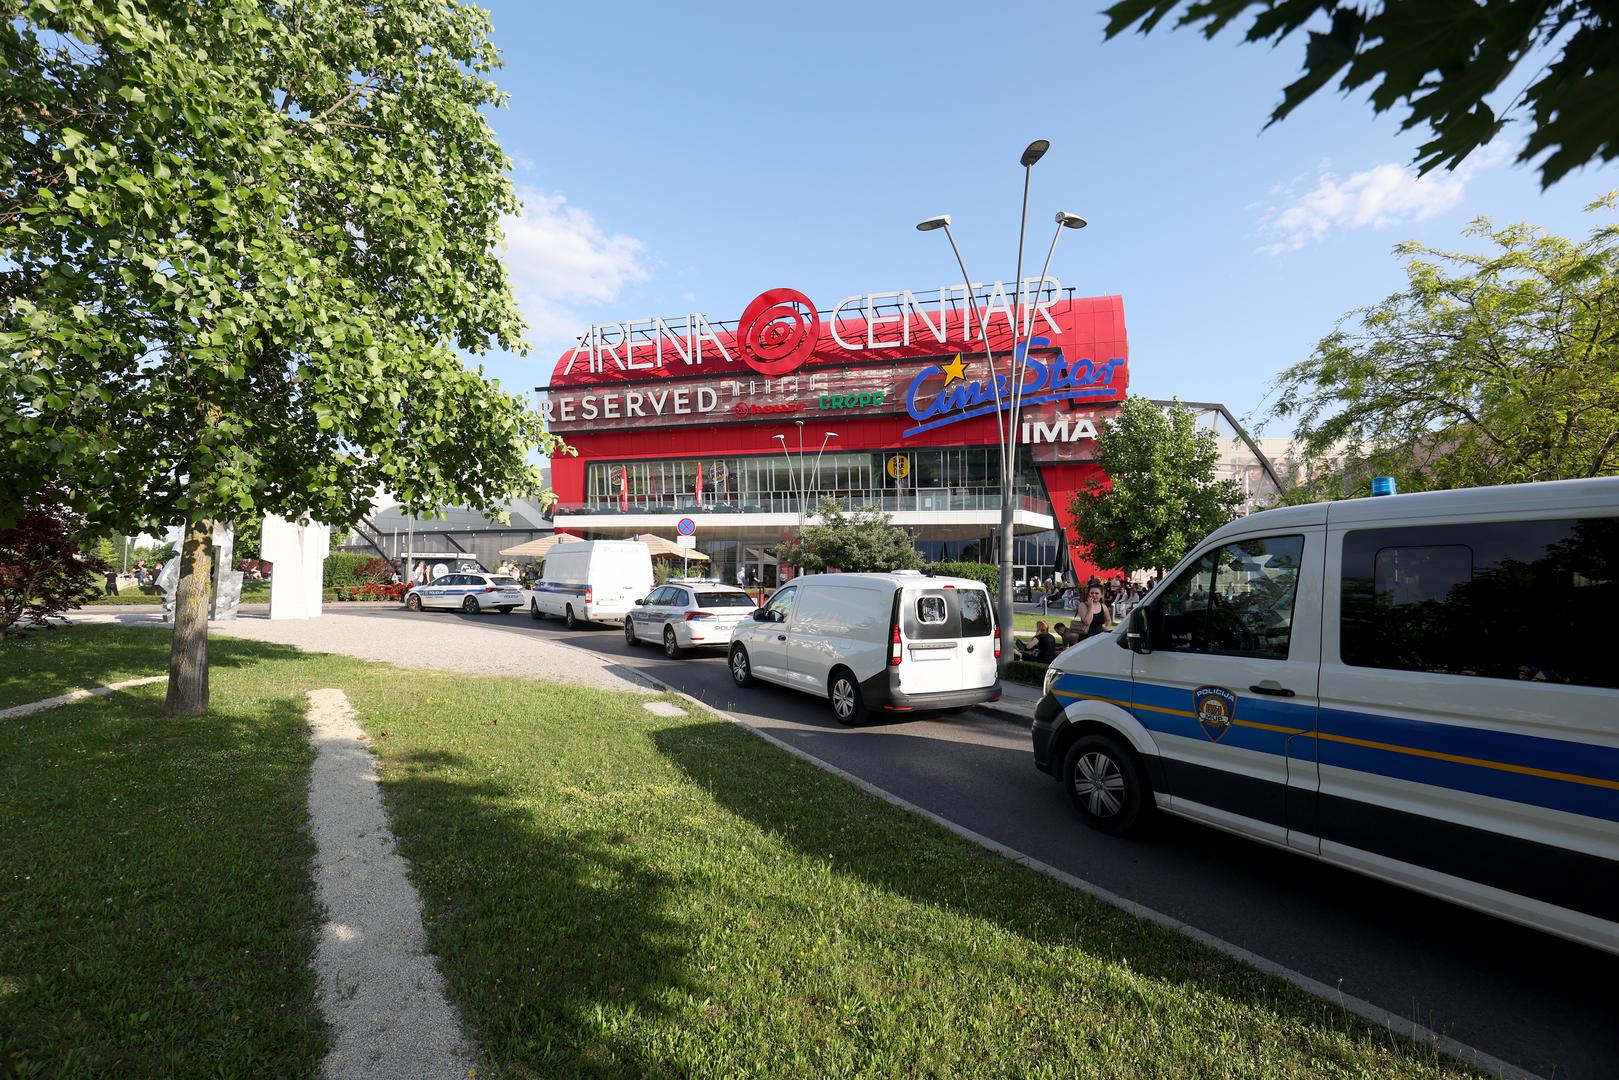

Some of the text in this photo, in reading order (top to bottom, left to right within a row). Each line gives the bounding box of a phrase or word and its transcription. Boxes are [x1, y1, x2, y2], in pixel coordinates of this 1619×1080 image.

[563, 275, 1063, 376] ARENA CENTAR
[732, 376, 815, 397] MOHITO
[538, 387, 718, 423] RESERVED
[818, 391, 885, 410] CROPP
[1196, 689, 1234, 702] POLICIJA
